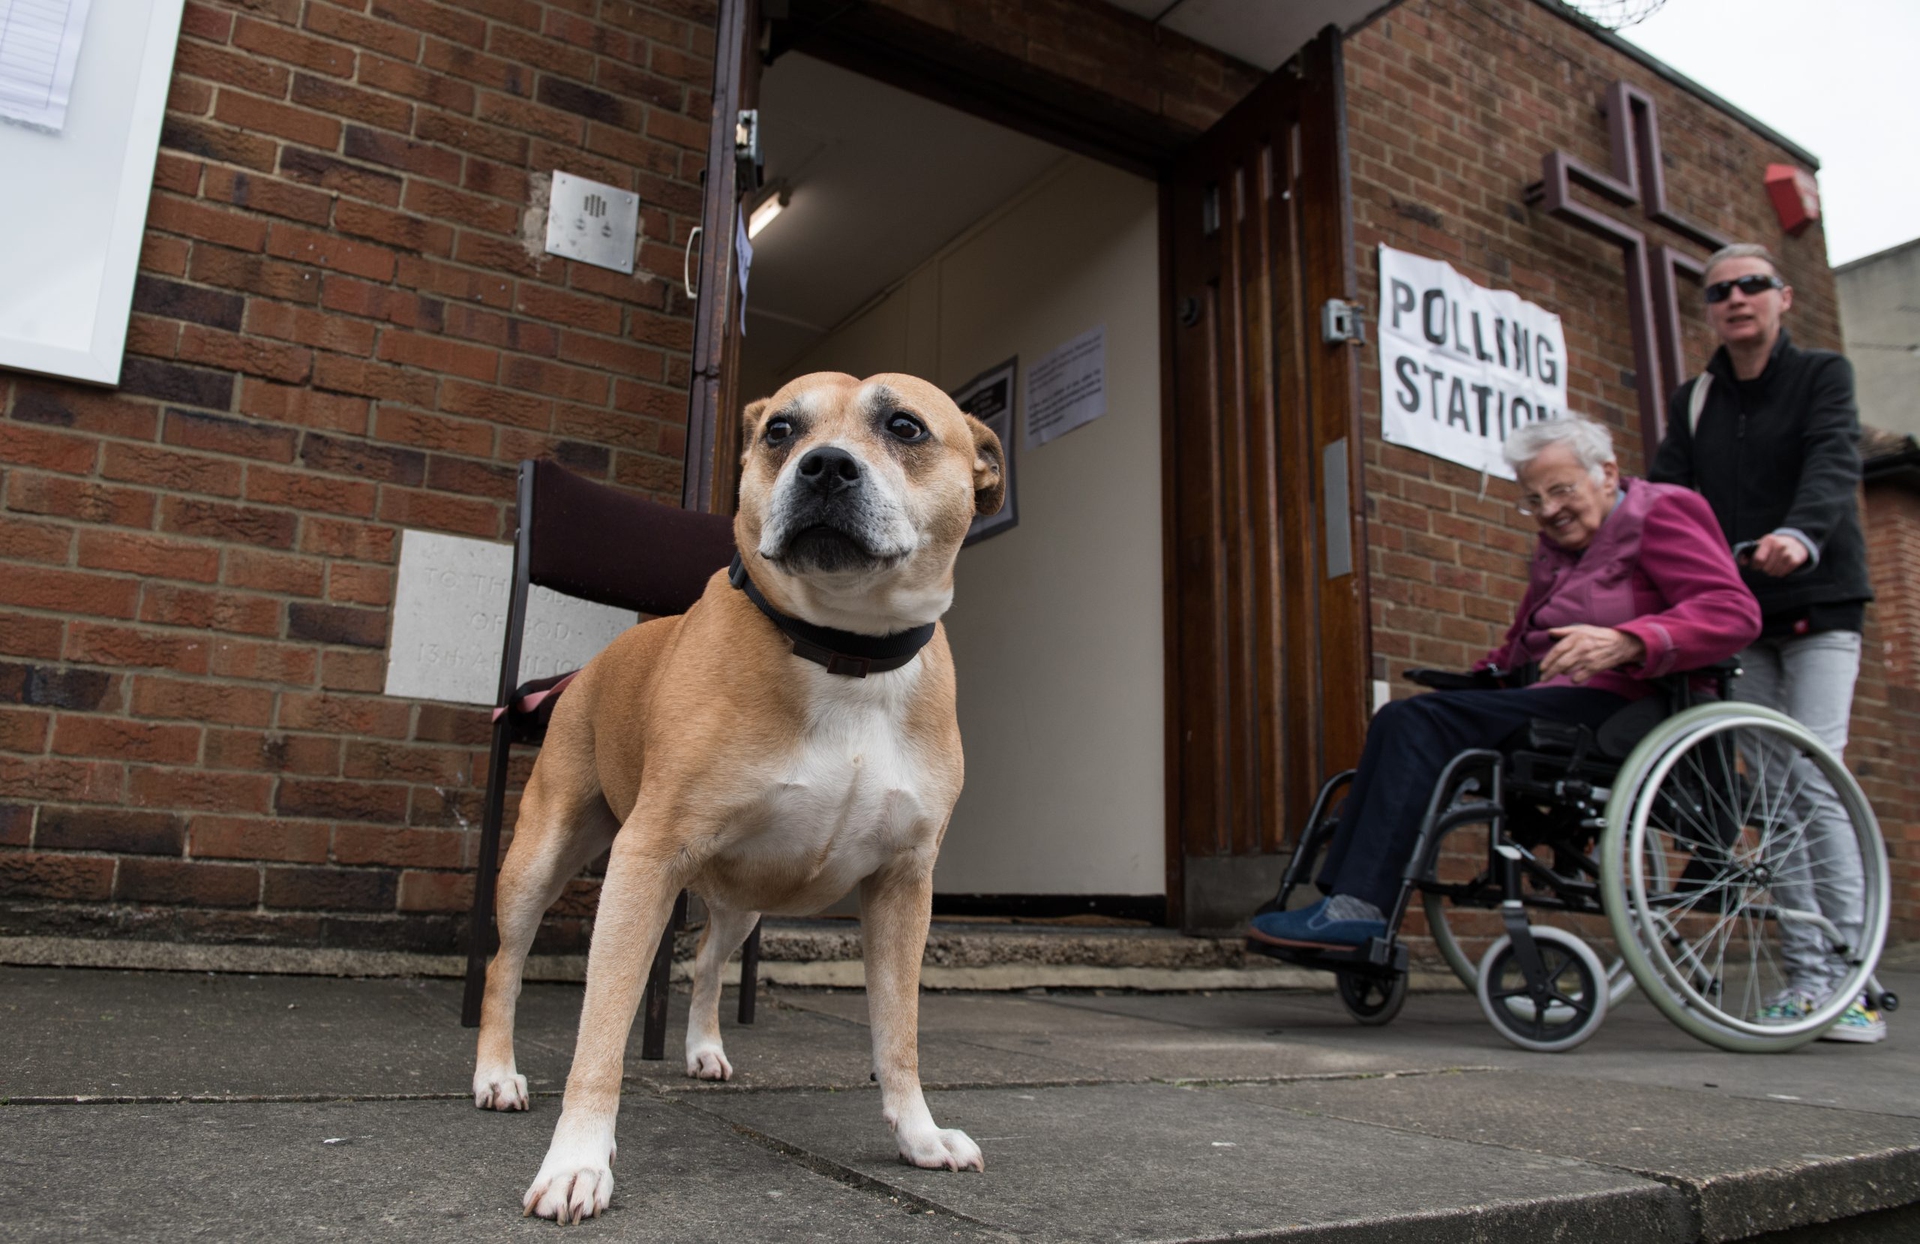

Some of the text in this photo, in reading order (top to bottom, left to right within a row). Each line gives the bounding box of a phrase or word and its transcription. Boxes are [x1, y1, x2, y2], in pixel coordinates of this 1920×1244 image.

[1390, 278, 1558, 387] POLLING
[1395, 355, 1558, 442] STATIO
[424, 566, 457, 590] TO
[471, 573, 507, 598] TH
[470, 611, 505, 635] OF
